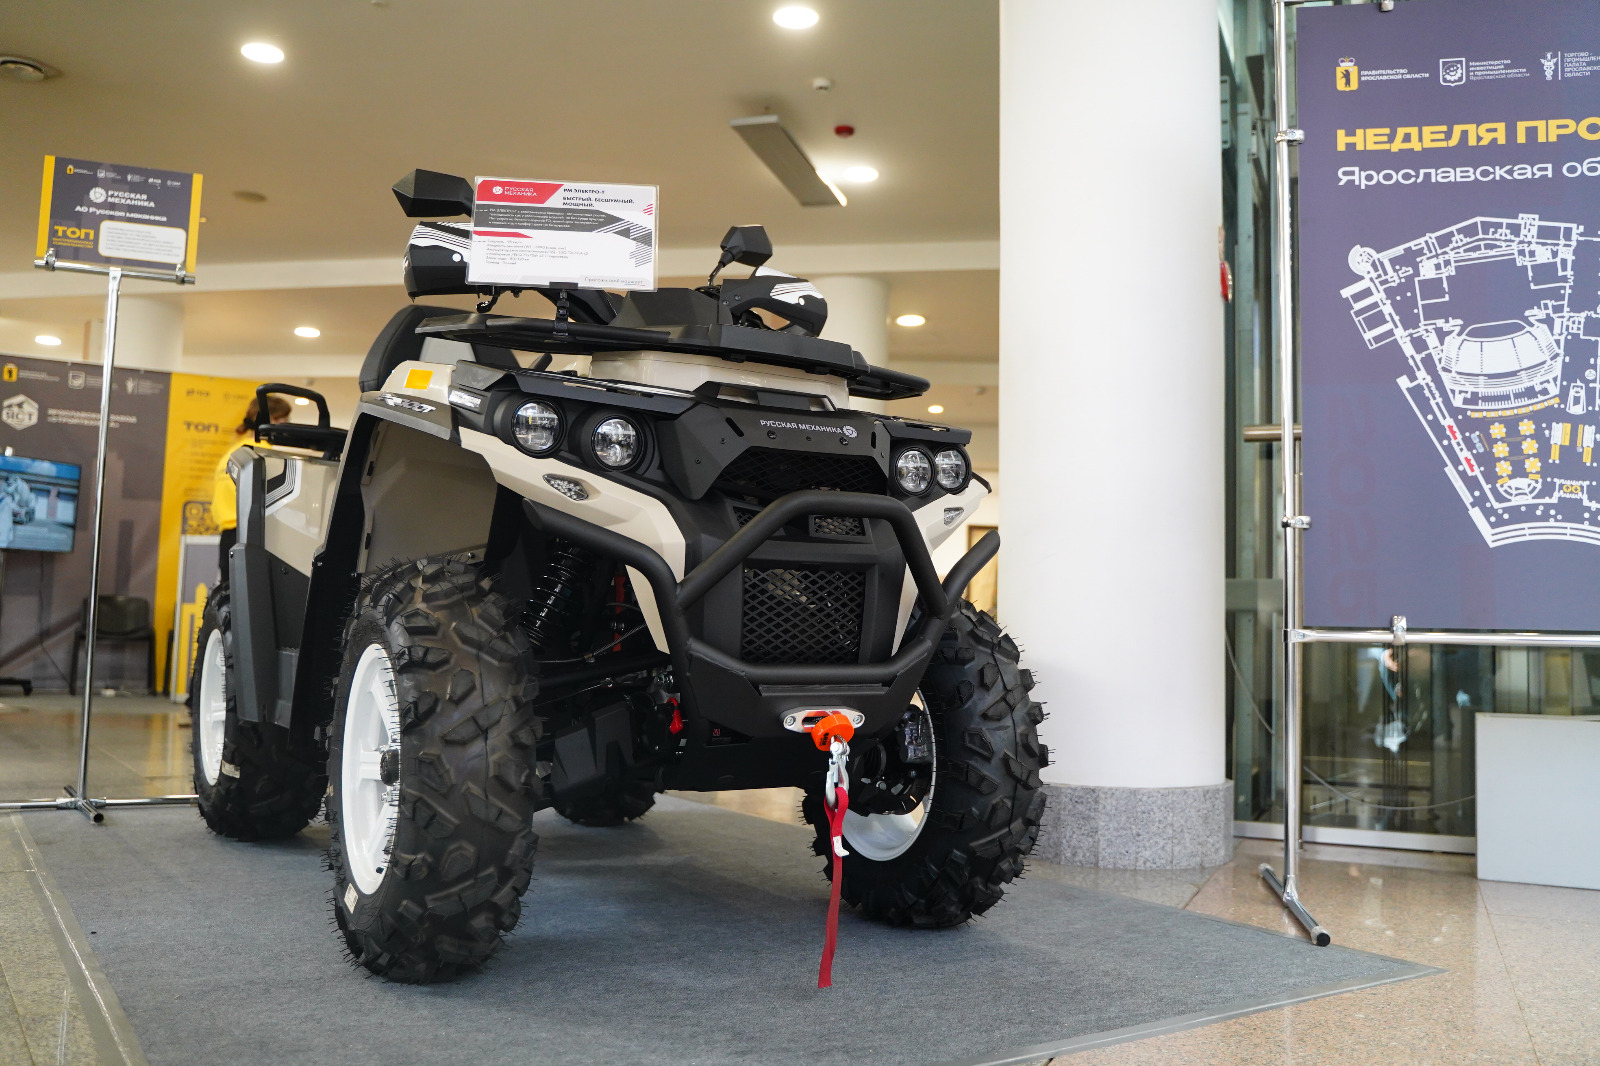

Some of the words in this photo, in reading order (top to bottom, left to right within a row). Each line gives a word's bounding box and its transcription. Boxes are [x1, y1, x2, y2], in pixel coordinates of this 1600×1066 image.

[1474, 68, 1527, 76] промышленности
[1336, 122, 1506, 152] НЕДЕЛЯ
[1516, 116, 1600, 144] ПРО
[1337, 163, 1552, 189] Ярославская
[1562, 157, 1600, 178] об
[108, 190, 147, 200] РУССКАЯ
[74, 205, 88, 213] АО
[107, 197, 155, 208] МЕХАНИКА
[54, 226, 95, 240] ТОП
[183, 420, 219, 433] ТОП
[759, 419, 798, 428] РУССКАЯ
[798, 423, 843, 434] МЕХАНИКА
